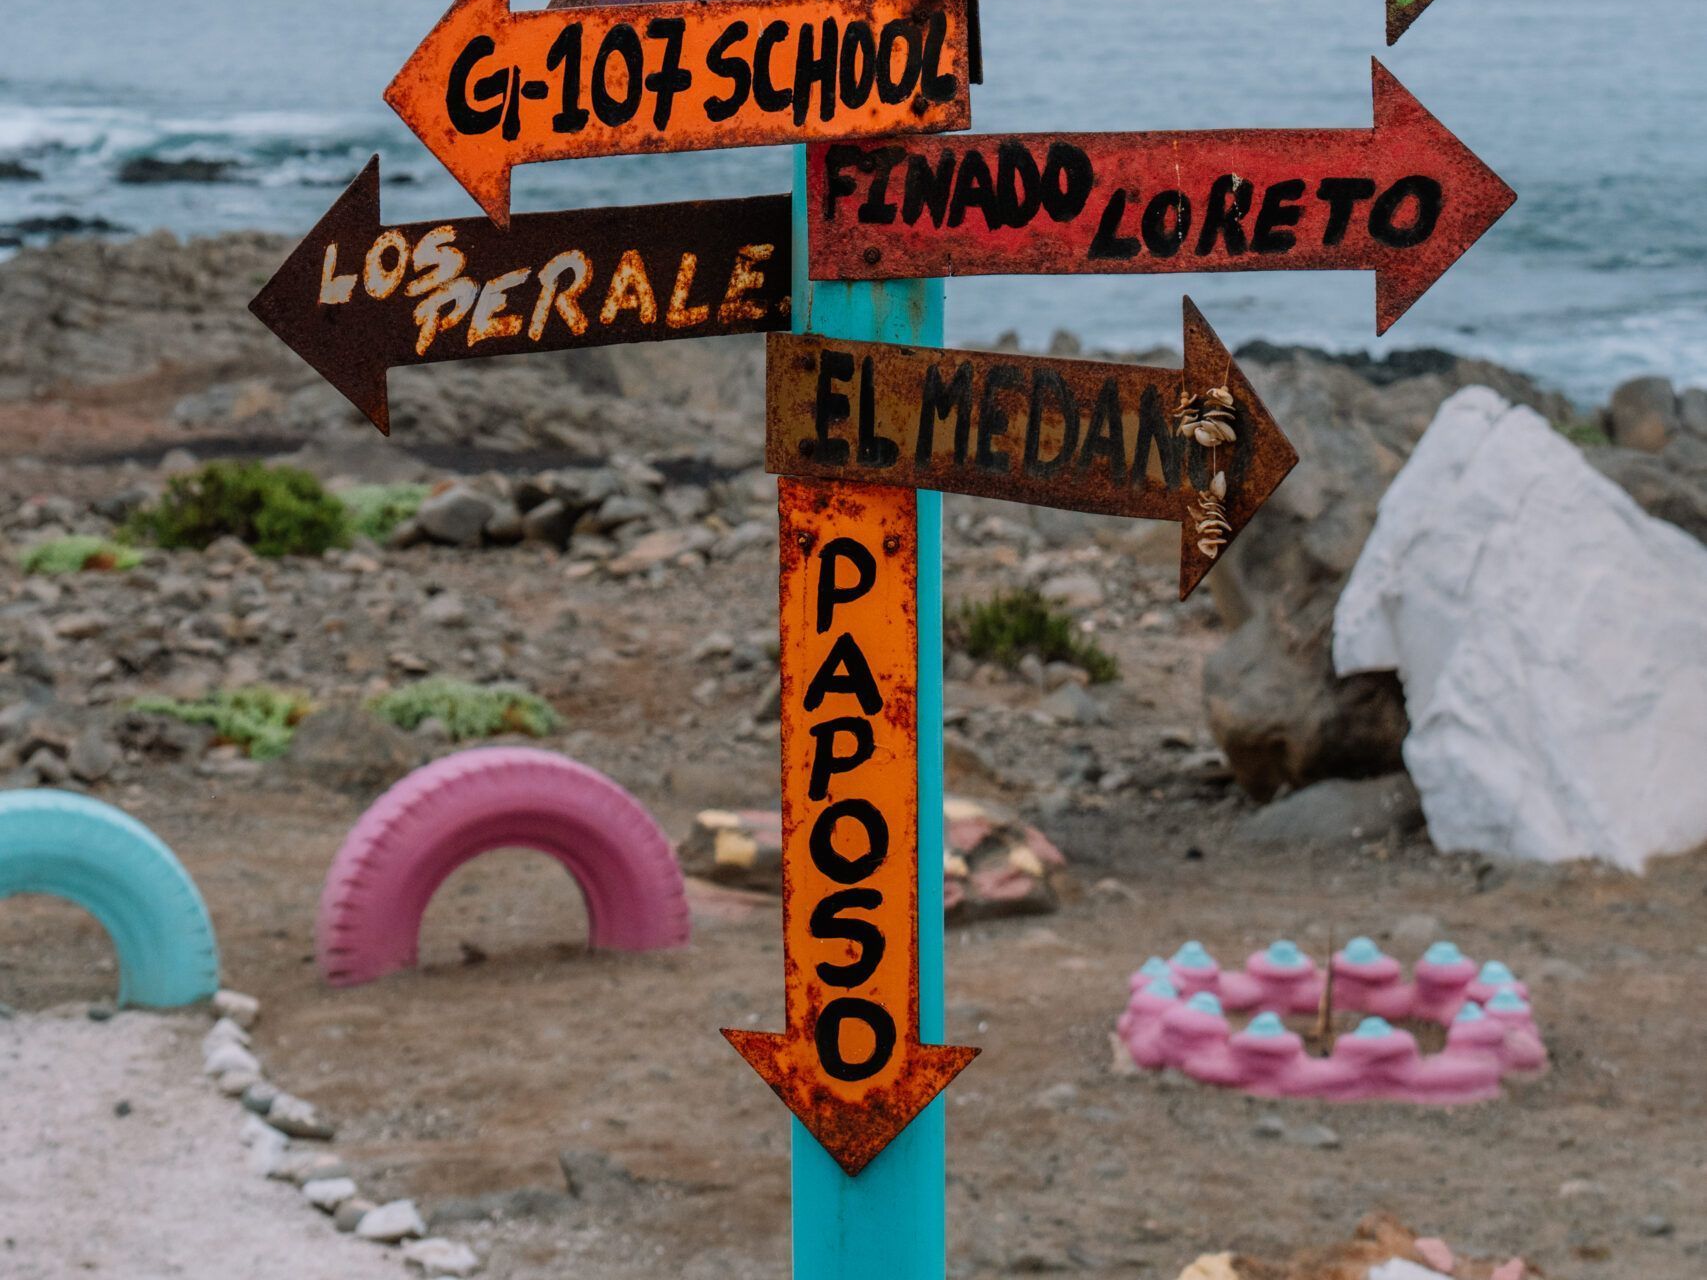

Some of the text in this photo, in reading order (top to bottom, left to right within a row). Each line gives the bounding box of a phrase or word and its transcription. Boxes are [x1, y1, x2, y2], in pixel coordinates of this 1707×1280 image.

[446, 18, 957, 141] G-107 SCHOOL
[824, 140, 1443, 261] FINADO LORETO
[318, 224, 791, 357] LOS PERALE
[812, 349, 900, 469] EL
[803, 536, 897, 1082] PAPOSO
